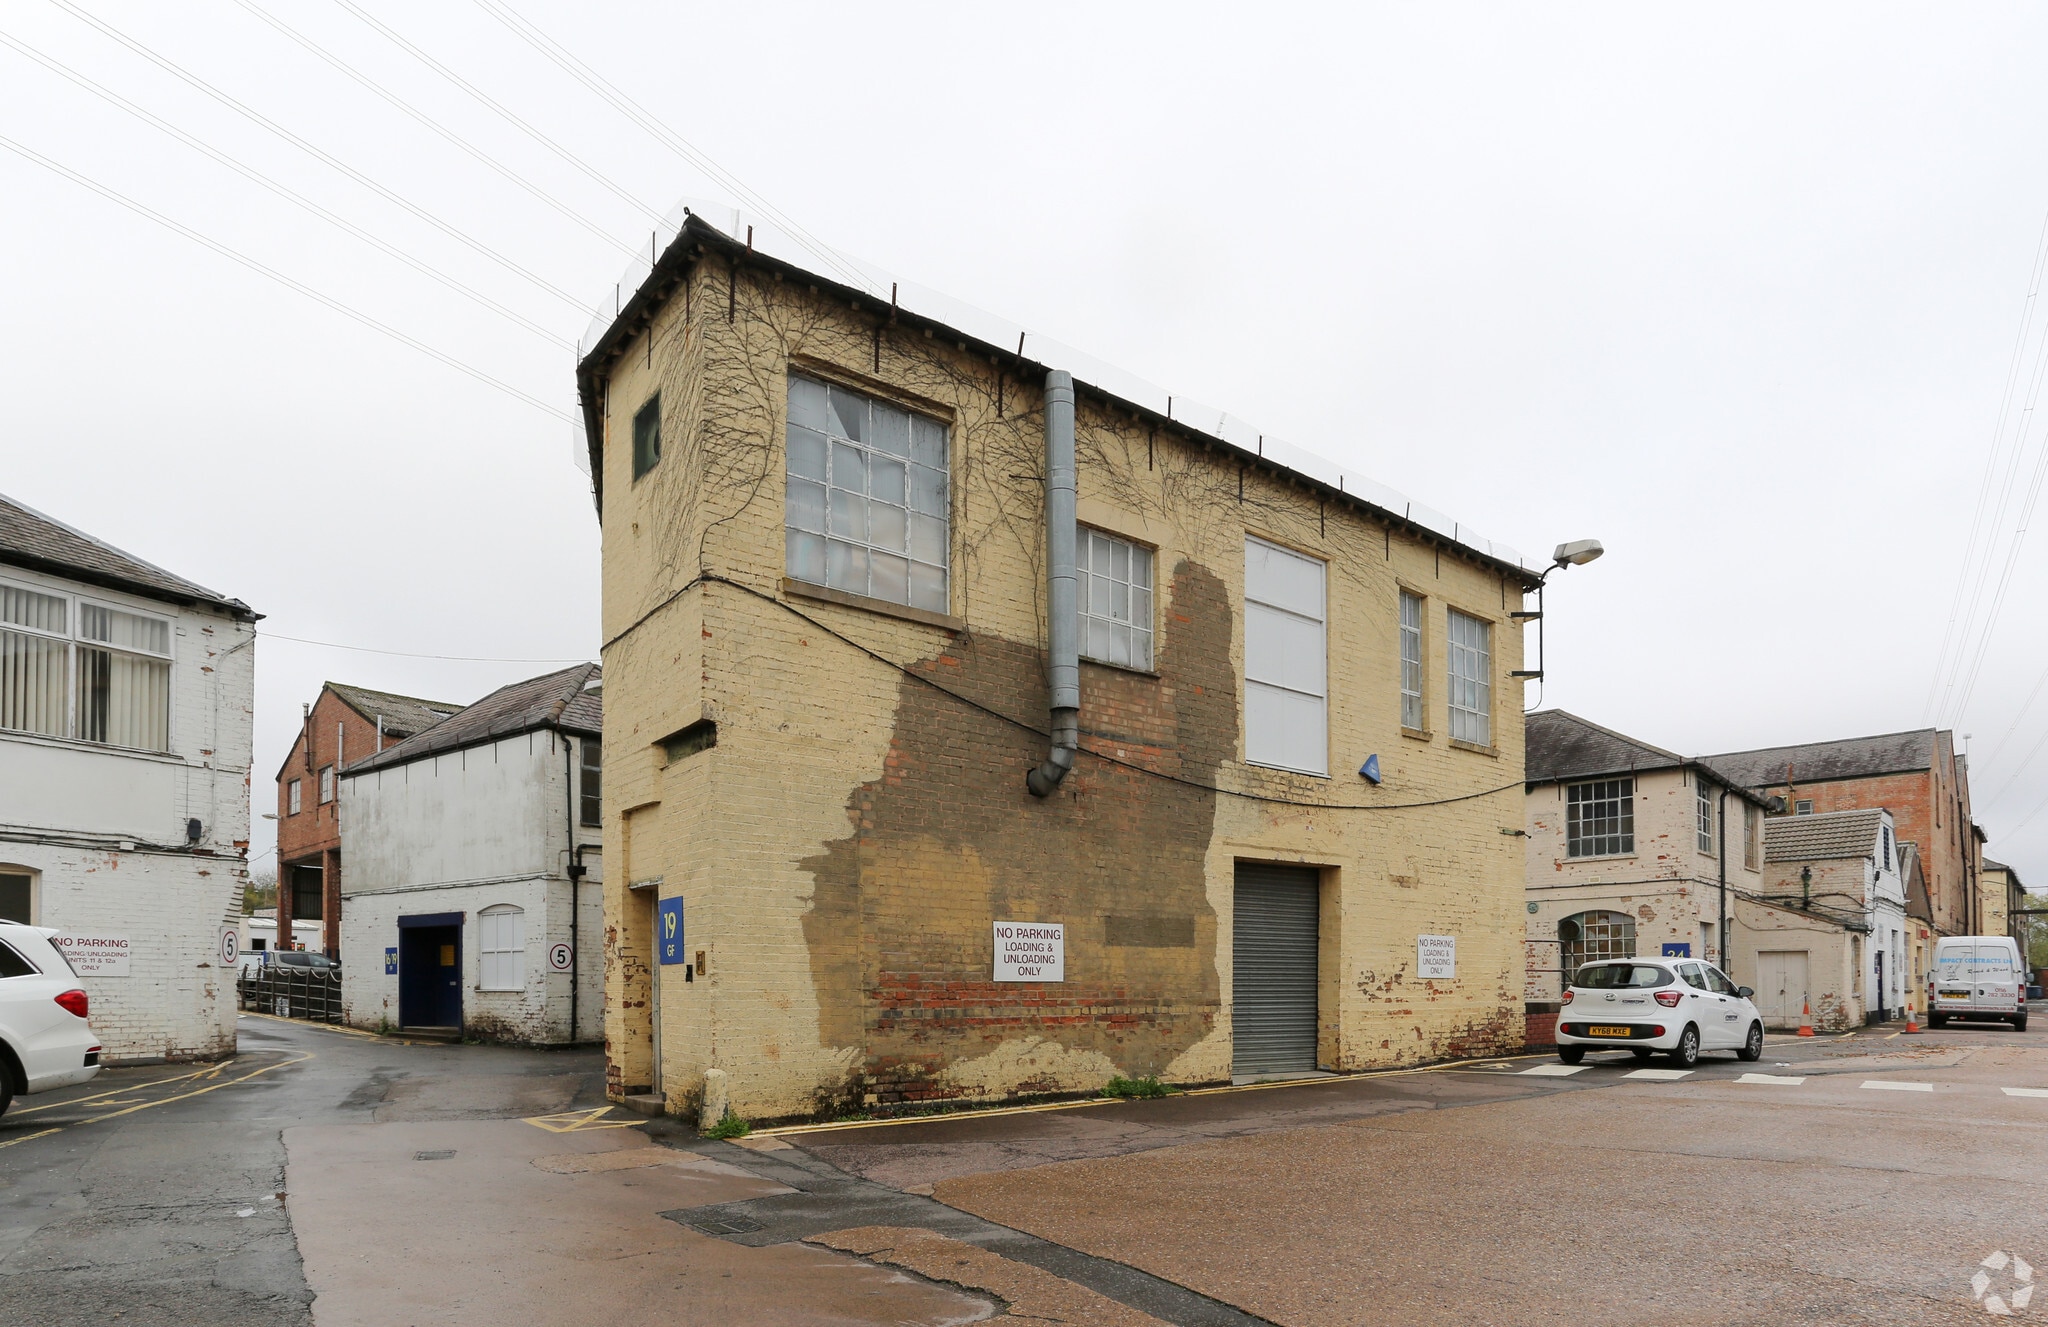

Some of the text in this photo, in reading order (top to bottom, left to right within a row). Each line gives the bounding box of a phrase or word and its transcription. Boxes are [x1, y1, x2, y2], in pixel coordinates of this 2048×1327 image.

[664, 912, 676, 939] 19
[997, 928, 1061, 940] NO PARKING
[55, 938, 128, 948] NO PARKING
[227, 938, 233, 956] 5
[1005, 942, 1053, 952] LOADING &
[1419, 939, 1454, 948] NO PARKING
[667, 944, 675, 957] GF
[557, 950, 566, 964] 5
[1004, 954, 1055, 964] UNLOADING
[1018, 966, 1041, 976] ONLY
[1592, 1027, 1627, 1035] KY68 MXE
